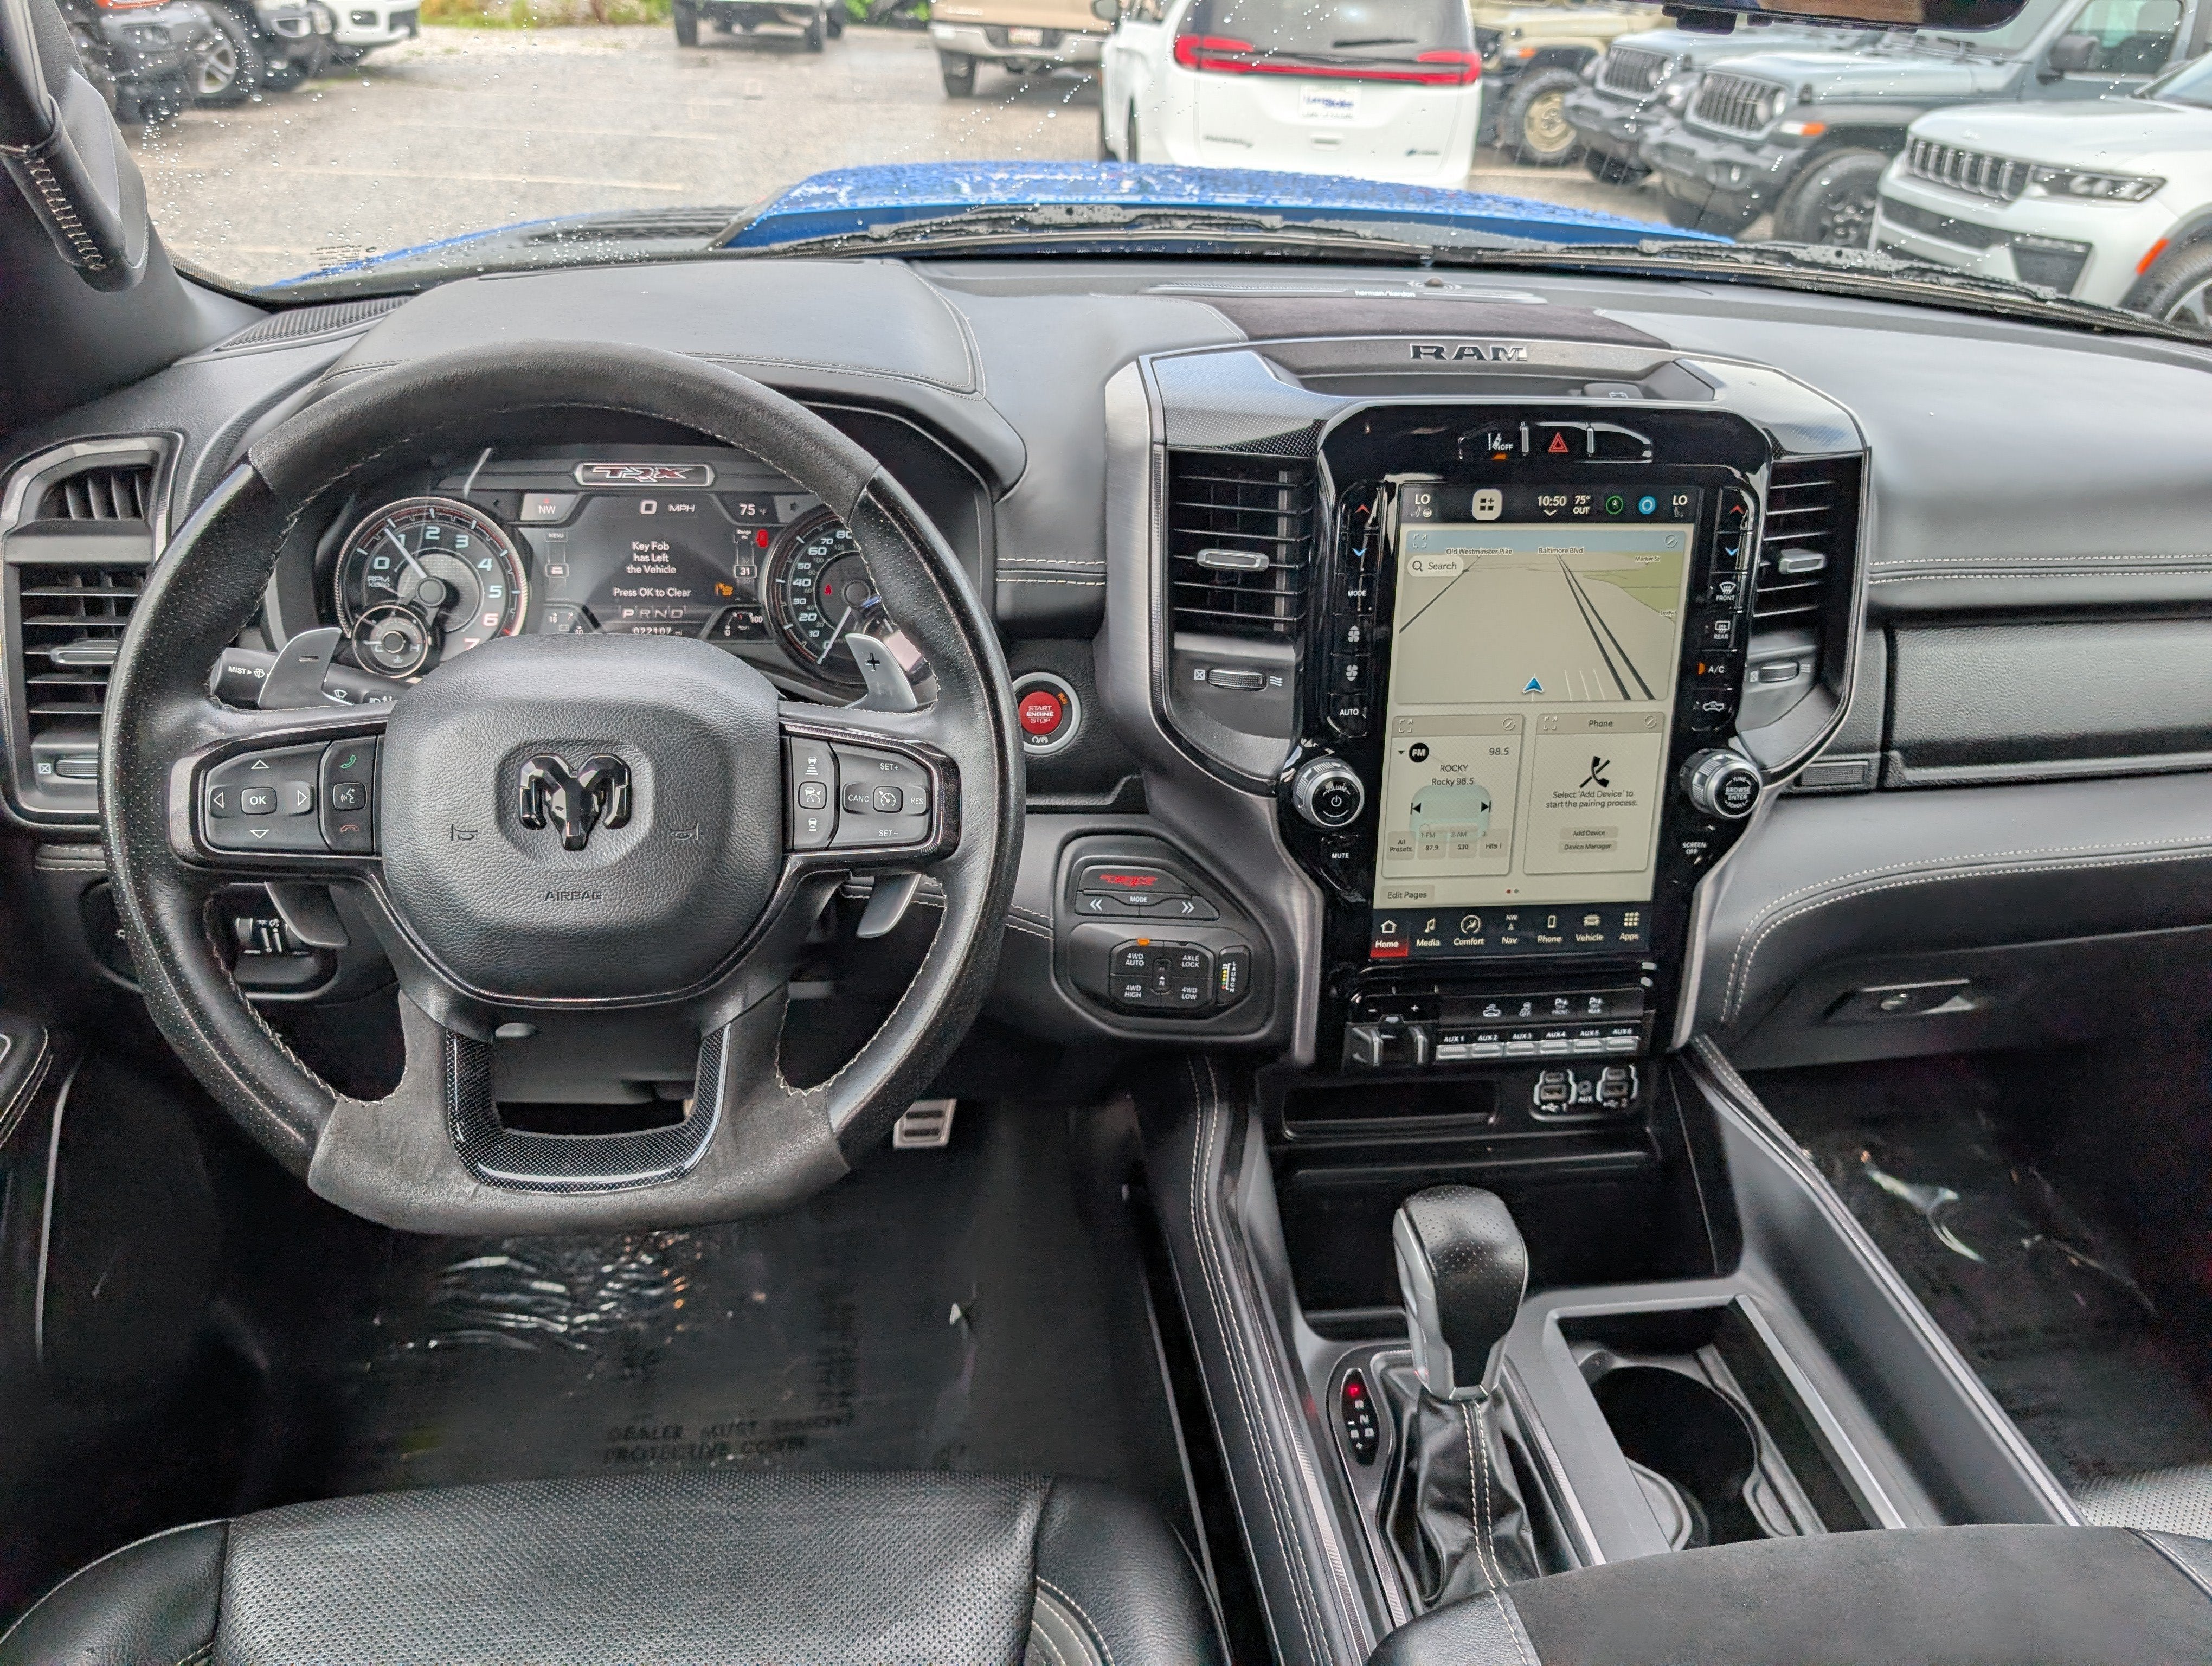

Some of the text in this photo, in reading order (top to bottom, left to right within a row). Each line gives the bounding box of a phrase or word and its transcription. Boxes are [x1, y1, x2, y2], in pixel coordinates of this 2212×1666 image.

[1410, 344, 1527, 361] RAM
[593, 466, 694, 483] TRX
[1415, 494, 1431, 504] LO
[1538, 495, 1567, 507] 10:50
[1673, 495, 1688, 505] LO
[538, 505, 556, 514] NW
[640, 499, 657, 515] 0
[739, 503, 755, 516] 75
[1573, 506, 1590, 514] OUT
[426, 526, 440, 540] 2
[398, 534, 406, 548] 1
[455, 535, 469, 548] 3
[632, 541, 670, 552] Key Fob
[808, 547, 827, 555] 60
[633, 553, 669, 562] has Left
[373, 556, 390, 569] 0
[478, 558, 492, 571] 4
[1427, 562, 1457, 570] Search
[626, 564, 677, 574] the Vehicle
[740, 567, 750, 575] 31
[793, 578, 811, 587] 40
[488, 585, 503, 598] 5
[613, 587, 692, 597] Press OK to Clear
[622, 608, 634, 618] P
[640, 609, 650, 618] R
[654, 609, 667, 618] N
[799, 613, 817, 621] 20
[483, 613, 498, 626] 6
[228, 665, 247, 675] MIST
[1708, 665, 1725, 674] A/C
[1412, 748, 1426, 757] FM
[1489, 747, 1509, 756] 98.5
[1440, 764, 1468, 772] ROCKY
[1432, 777, 1474, 786] Rocky 98.5
[848, 794, 869, 803] CANC
[1553, 791, 1576, 799] Select
[249, 796, 267, 805] OK
[1579, 800, 1605, 809] pairing
[1607, 800, 1638, 808] process.
[543, 890, 605, 901] AIRBAG
[1404, 891, 1427, 900] Pages
[1576, 933, 1604, 942] Vehicle
[1619, 933, 1639, 941] Apps
[1375, 940, 1399, 948] Home
[1454, 938, 1485, 946] Comfort
[1360, 1415, 1369, 1425] N
